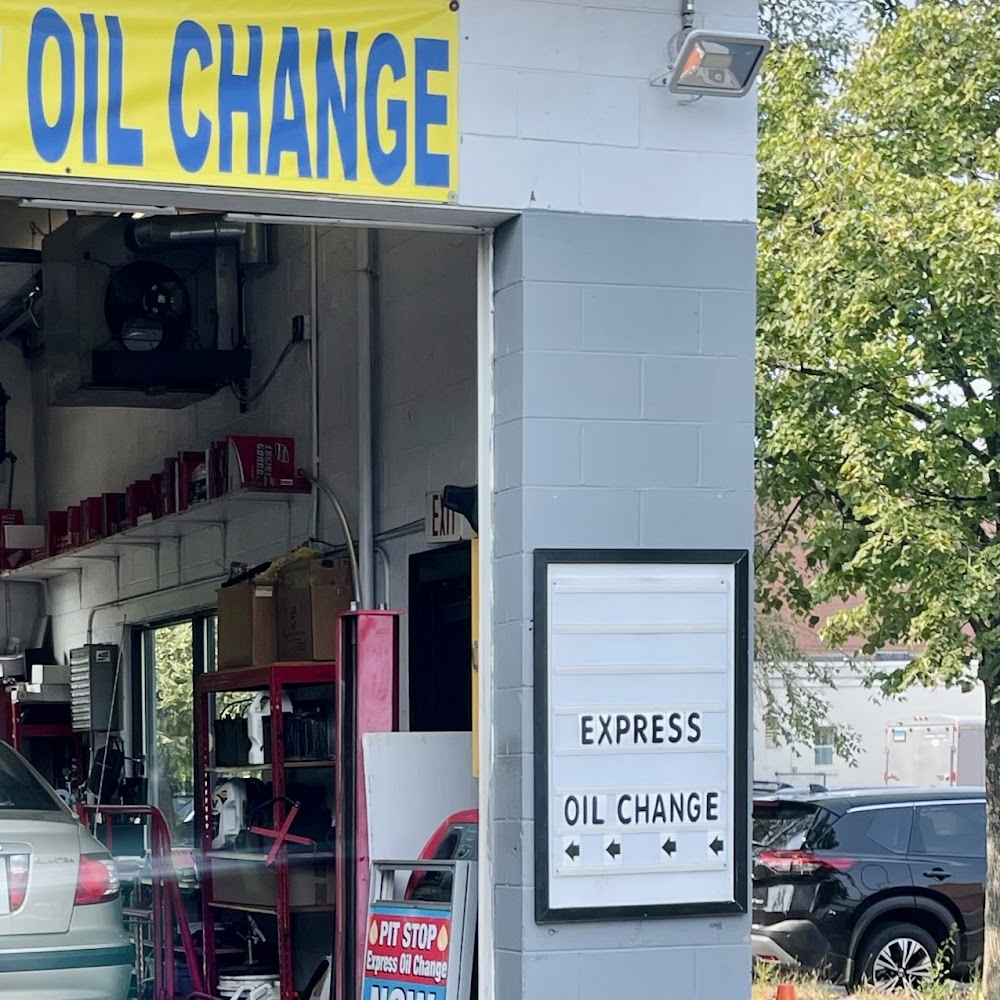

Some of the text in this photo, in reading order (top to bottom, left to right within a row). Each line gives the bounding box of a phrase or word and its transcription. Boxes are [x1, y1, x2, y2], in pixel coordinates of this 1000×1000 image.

[27, 7, 144, 167] OIL
[168, 20, 450, 188] CHANGE
[581, 712, 702, 745] EXPRESS
[564, 792, 719, 826] OIL CHANGE
[379, 920, 437, 950] PIT STOP
[366, 950, 447, 983] Express Oil Change
